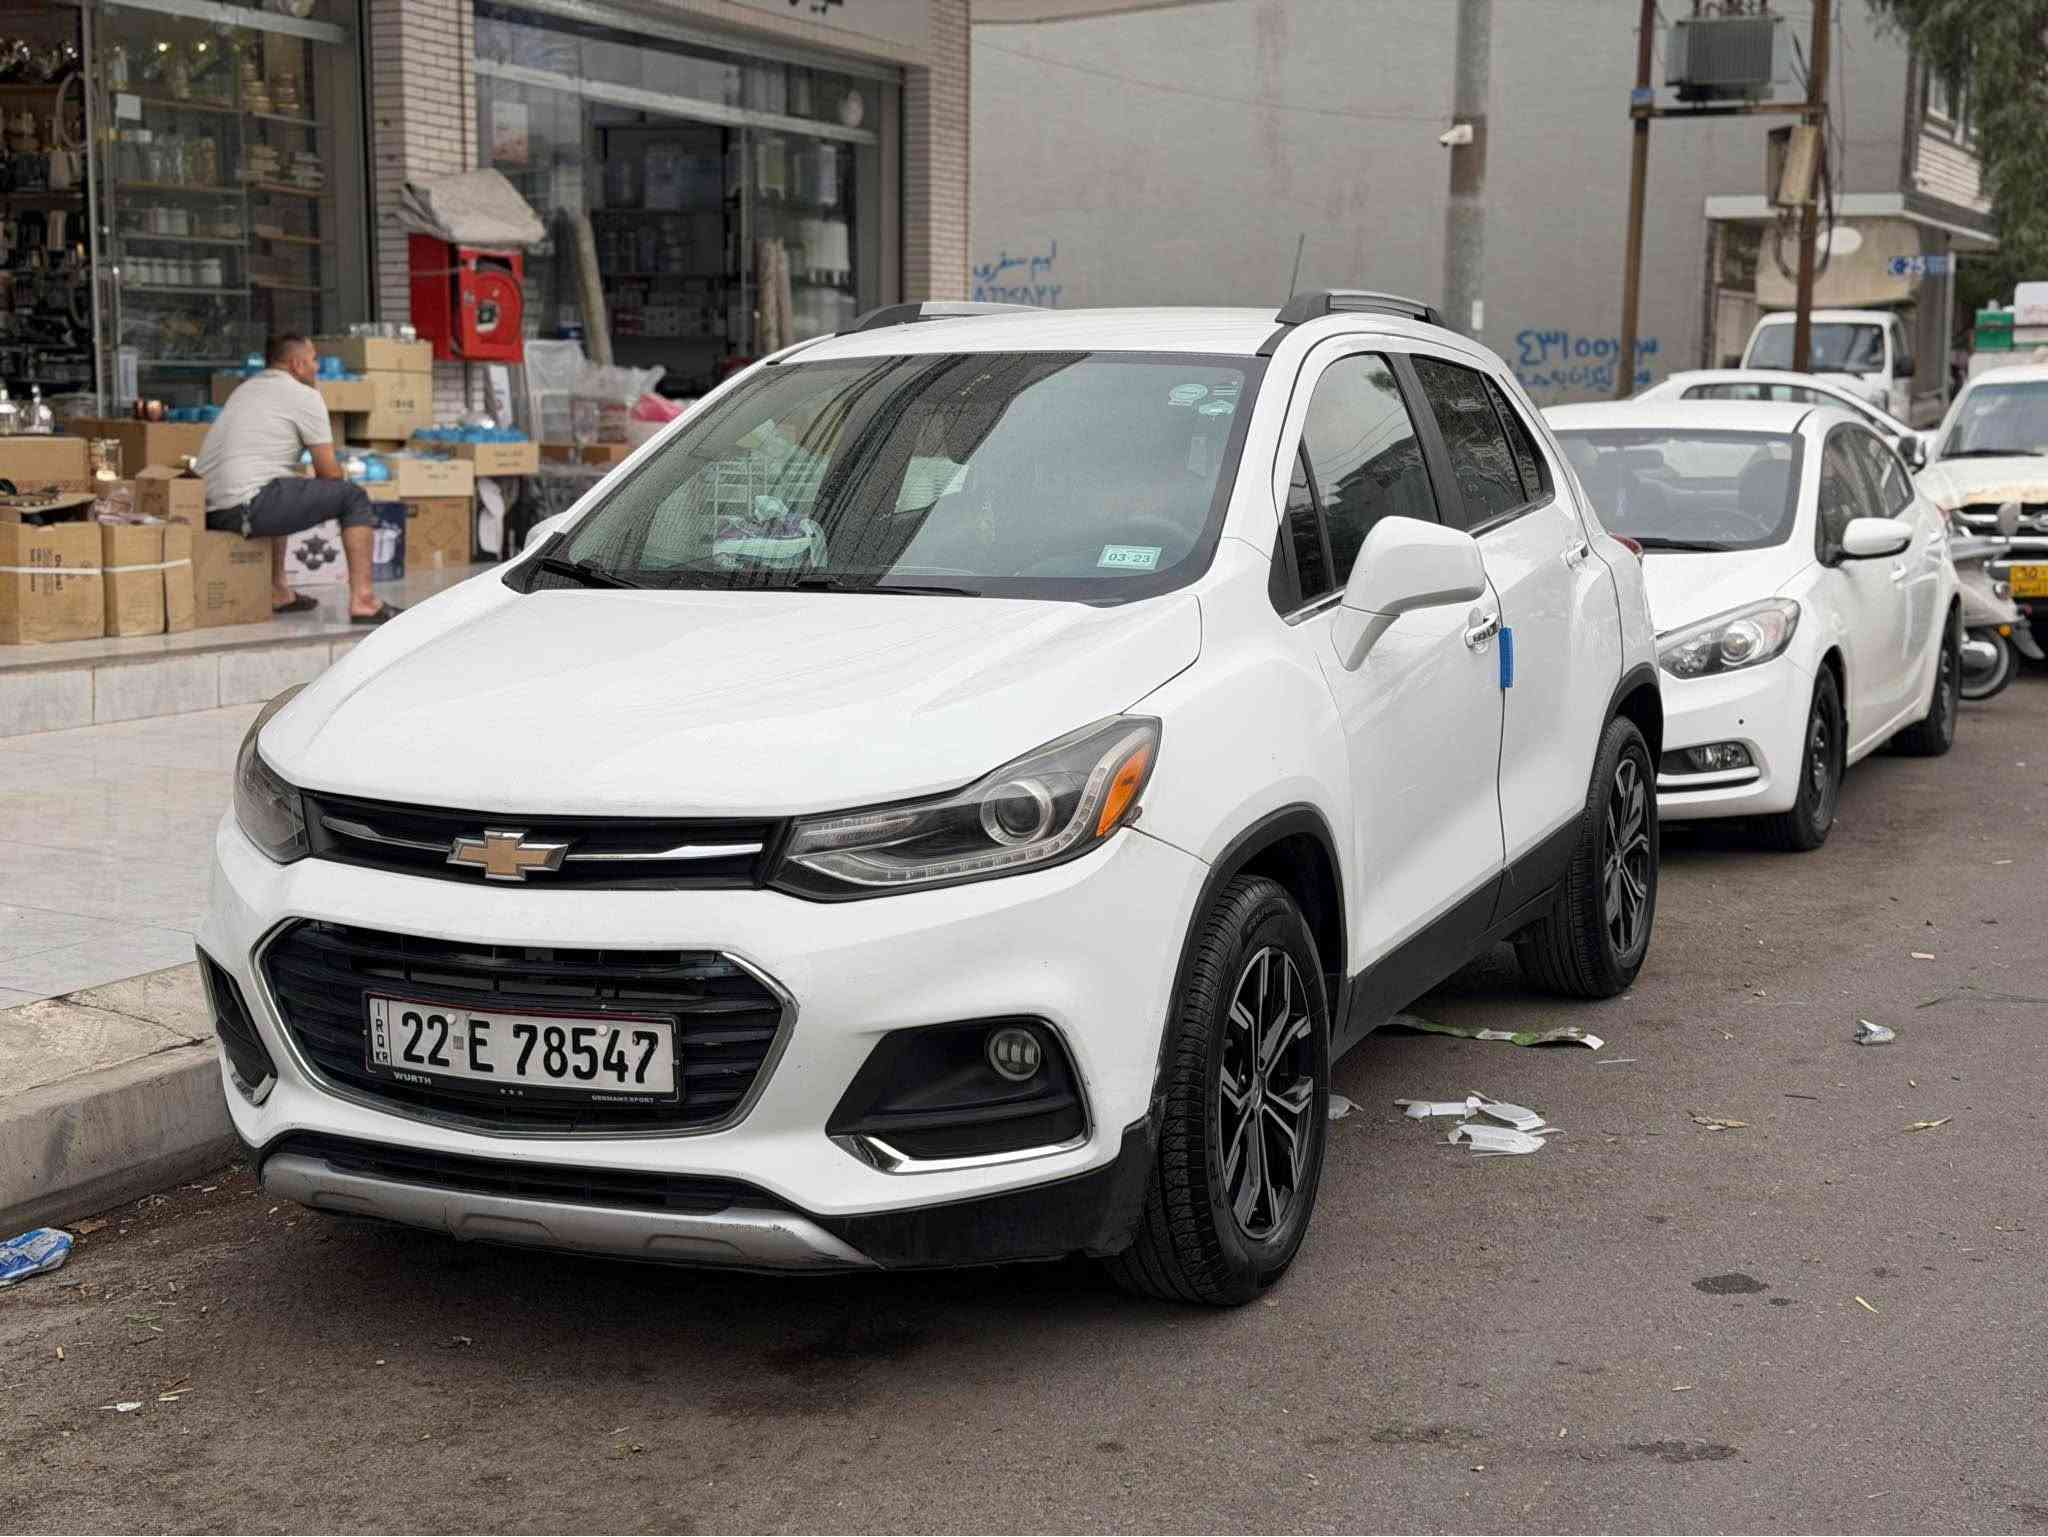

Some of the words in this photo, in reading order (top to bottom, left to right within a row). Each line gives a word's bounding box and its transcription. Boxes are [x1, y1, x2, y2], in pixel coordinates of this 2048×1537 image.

[375, 1001, 385, 1049] IRQ
[401, 1011, 450, 1067] 22
[468, 1018, 494, 1074] E
[512, 1023, 659, 1084] 78547
[375, 1050, 389, 1064] KR
